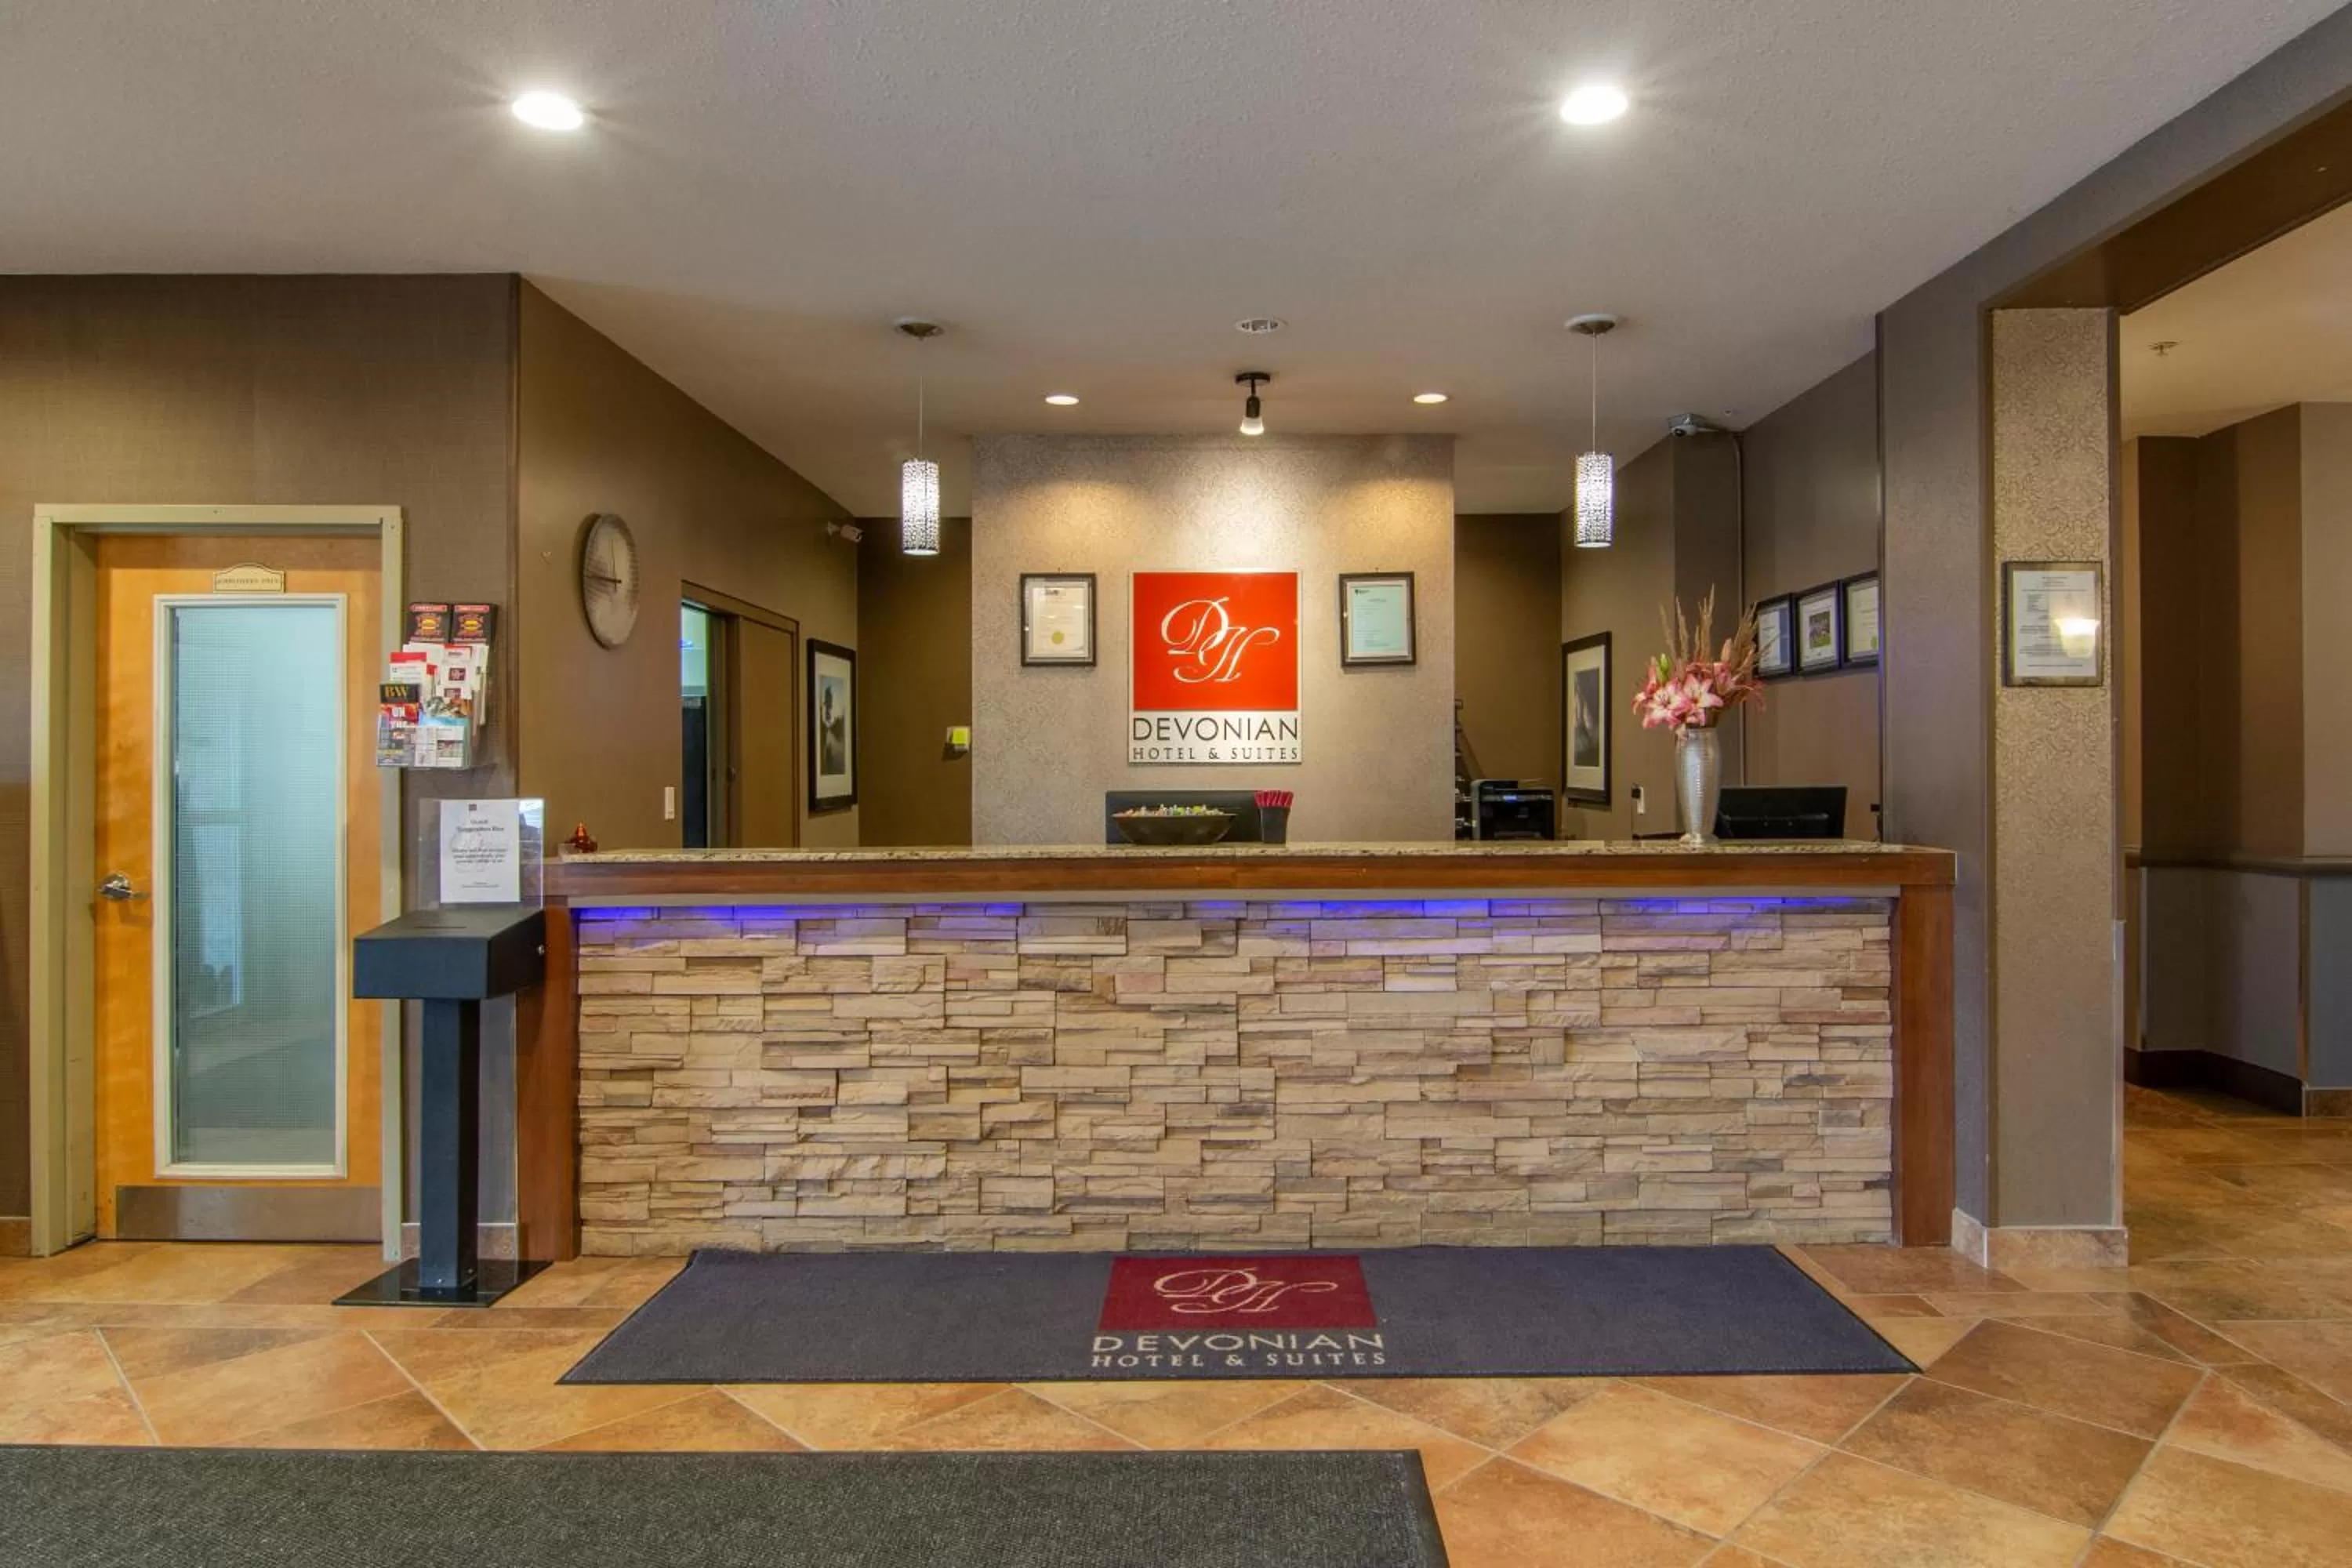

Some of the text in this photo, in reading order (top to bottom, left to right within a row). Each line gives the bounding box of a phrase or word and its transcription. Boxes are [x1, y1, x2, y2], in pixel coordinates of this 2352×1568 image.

[1133, 717, 1298, 741] DEVONIAN
[1133, 747, 1298, 760] HOTEL & SUITES
[1092, 1334, 1385, 1352] DEVONIAN
[1091, 1352, 1386, 1368] HOTEL & SUITES
